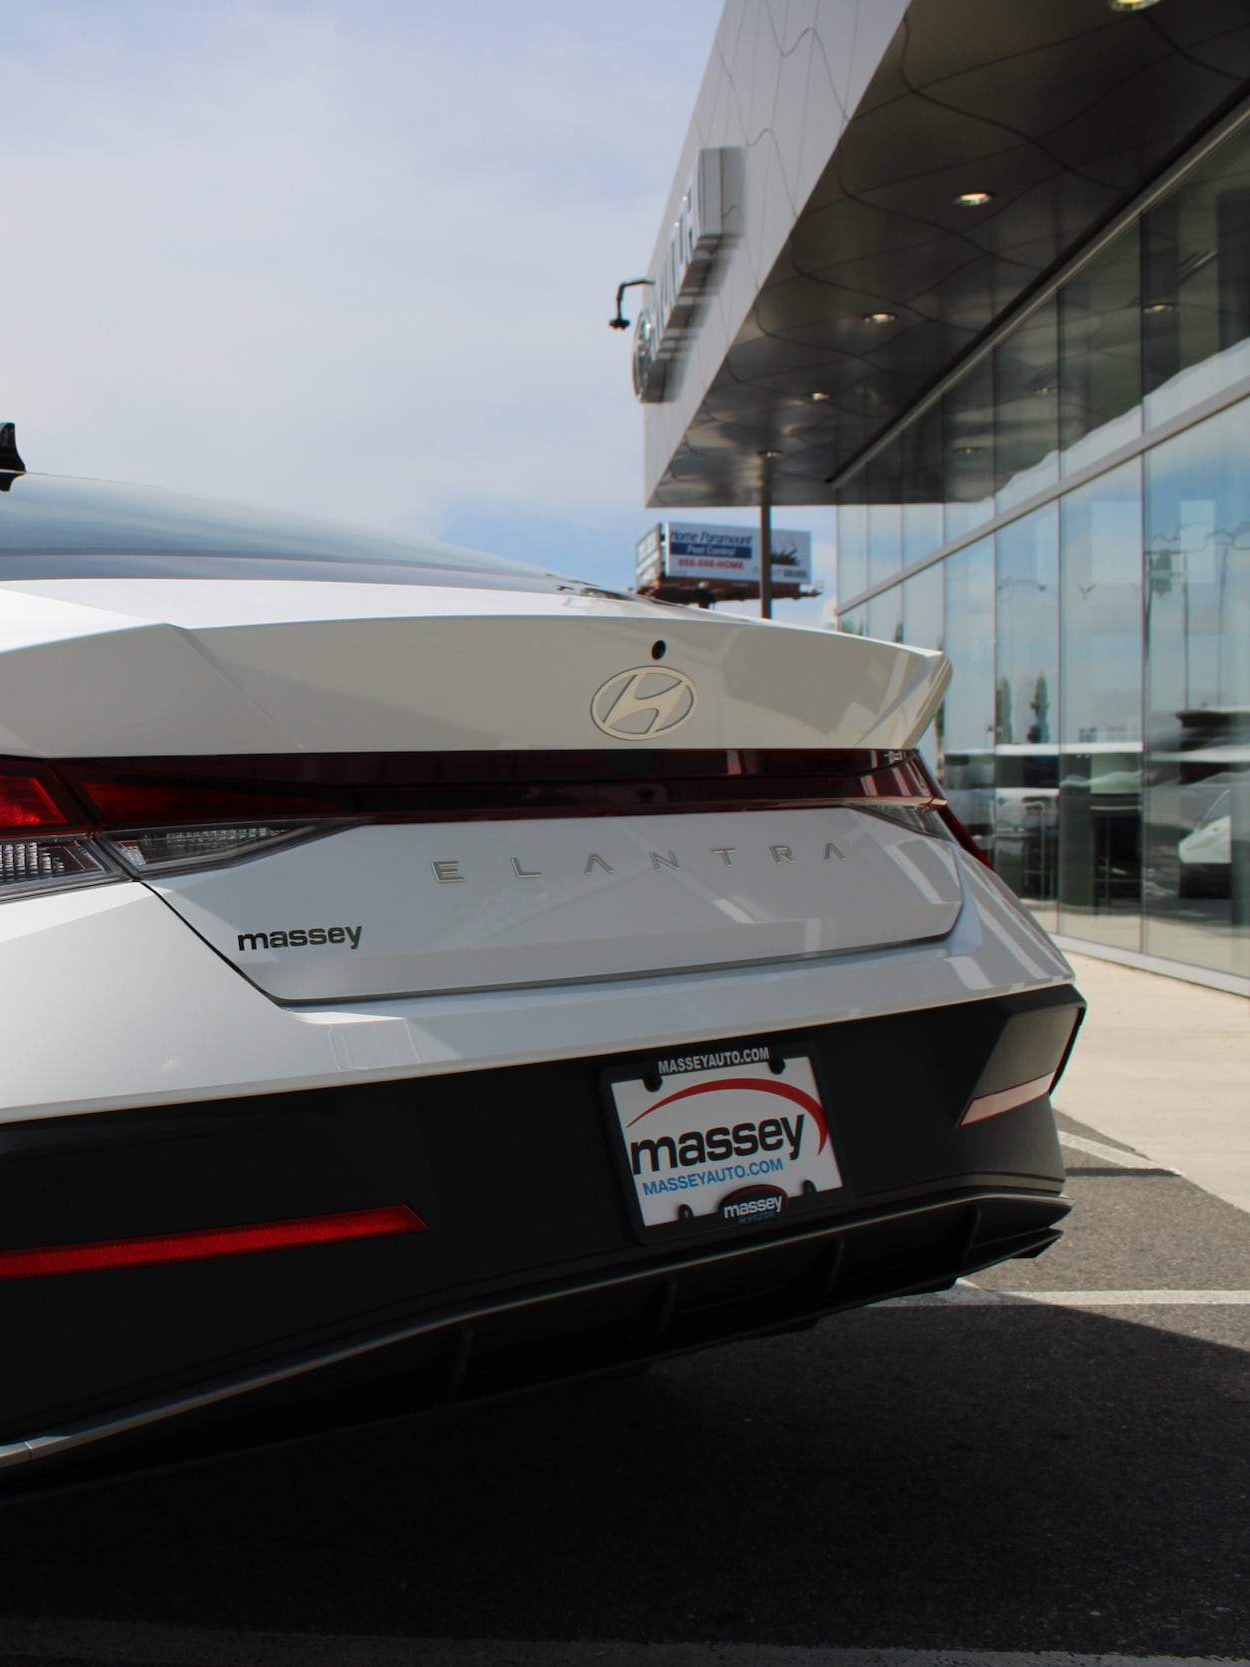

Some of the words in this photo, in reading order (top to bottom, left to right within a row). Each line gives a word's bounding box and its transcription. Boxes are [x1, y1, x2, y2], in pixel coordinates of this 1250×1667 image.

[671, 530, 698, 543] Home
[700, 532, 753, 545] Paramount
[686, 544, 705, 554] Pest
[707, 546, 736, 556] Control
[430, 843, 846, 884] ELANTRA
[237, 926, 363, 951] massey
[658, 1047, 770, 1075] MASSEYAUTO.COM
[630, 1114, 805, 1176] massey
[642, 1158, 784, 1196] MASSEYAUTO.COM
[724, 1196, 783, 1219] massey
